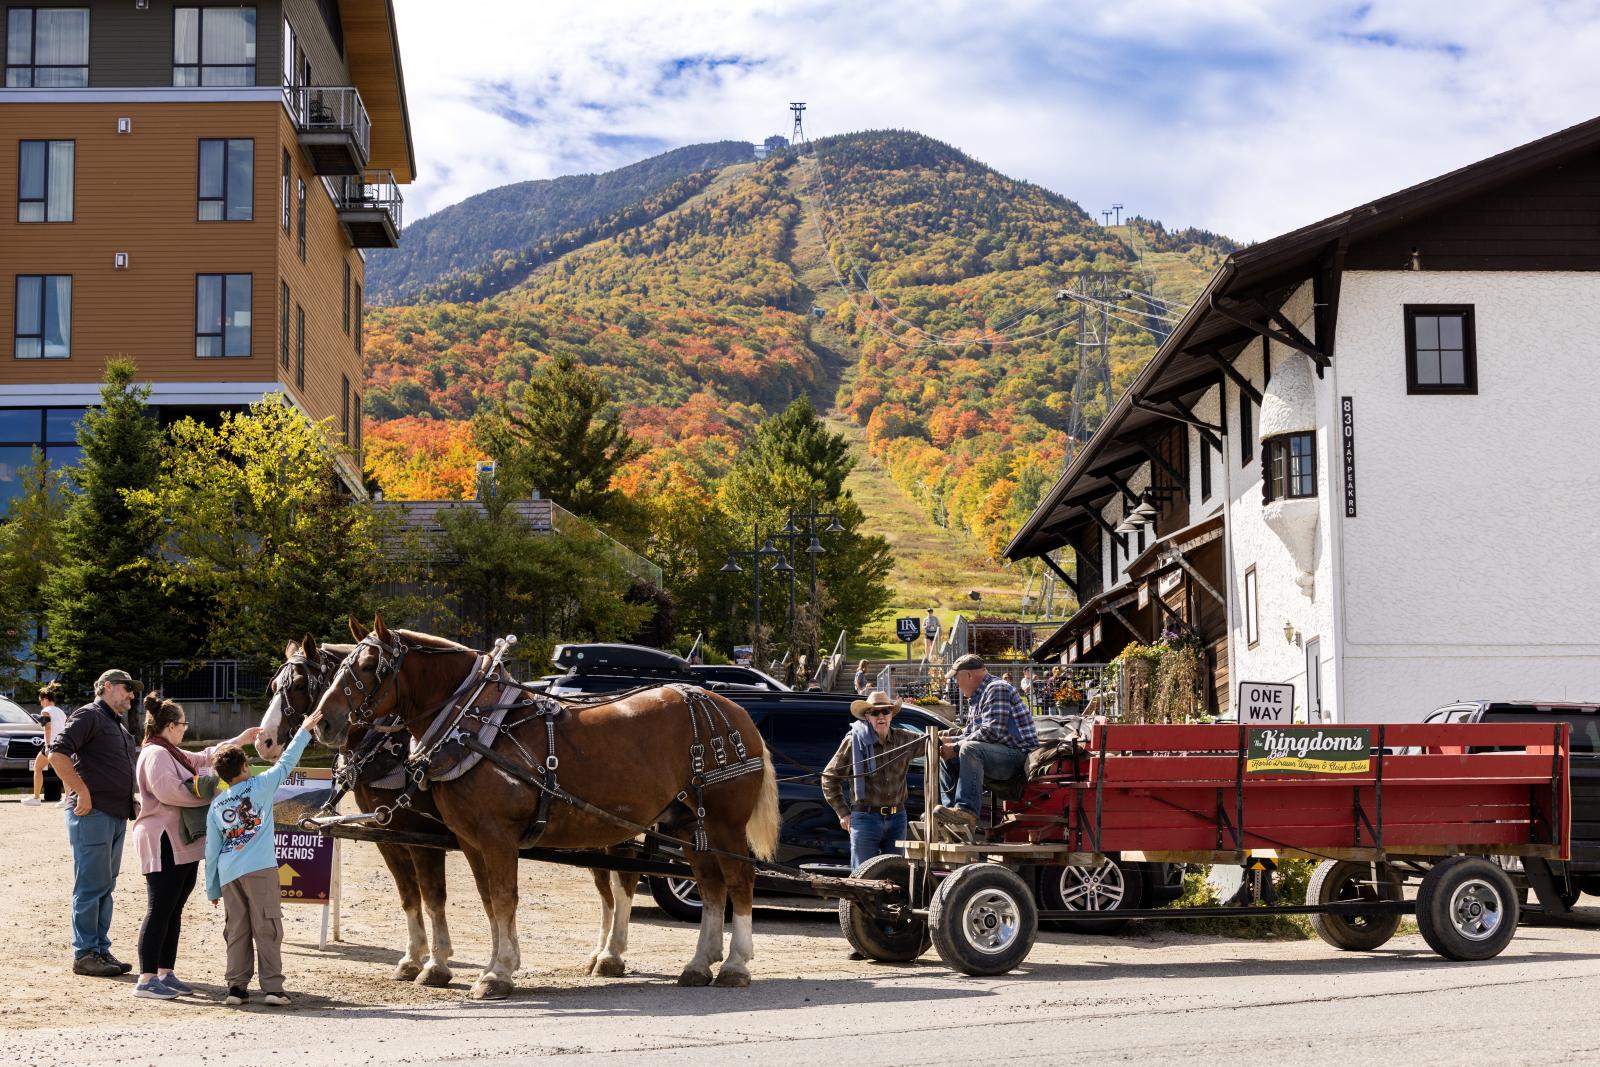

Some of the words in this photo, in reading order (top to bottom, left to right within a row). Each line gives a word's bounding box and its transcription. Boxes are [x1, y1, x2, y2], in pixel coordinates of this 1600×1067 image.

[1343, 400, 1353, 437] 830
[1348, 500, 1354, 514] RD
[1250, 689, 1282, 703] ONE
[1249, 706, 1283, 720] WAY
[1261, 729, 1364, 758] Kingdom's
[1266, 748, 1289, 760] Best
[1252, 760, 1272, 769] Horse
[1273, 760, 1297, 768] Drawn
[1298, 760, 1320, 770] Wagon
[1321, 761, 1327, 769] &
[1329, 761, 1347, 771] Sleigh
[1348, 762, 1367, 770] Rides
[273, 834, 288, 846] NIC
[291, 834, 324, 847] ROUTE
[275, 847, 315, 860] EKENDS
